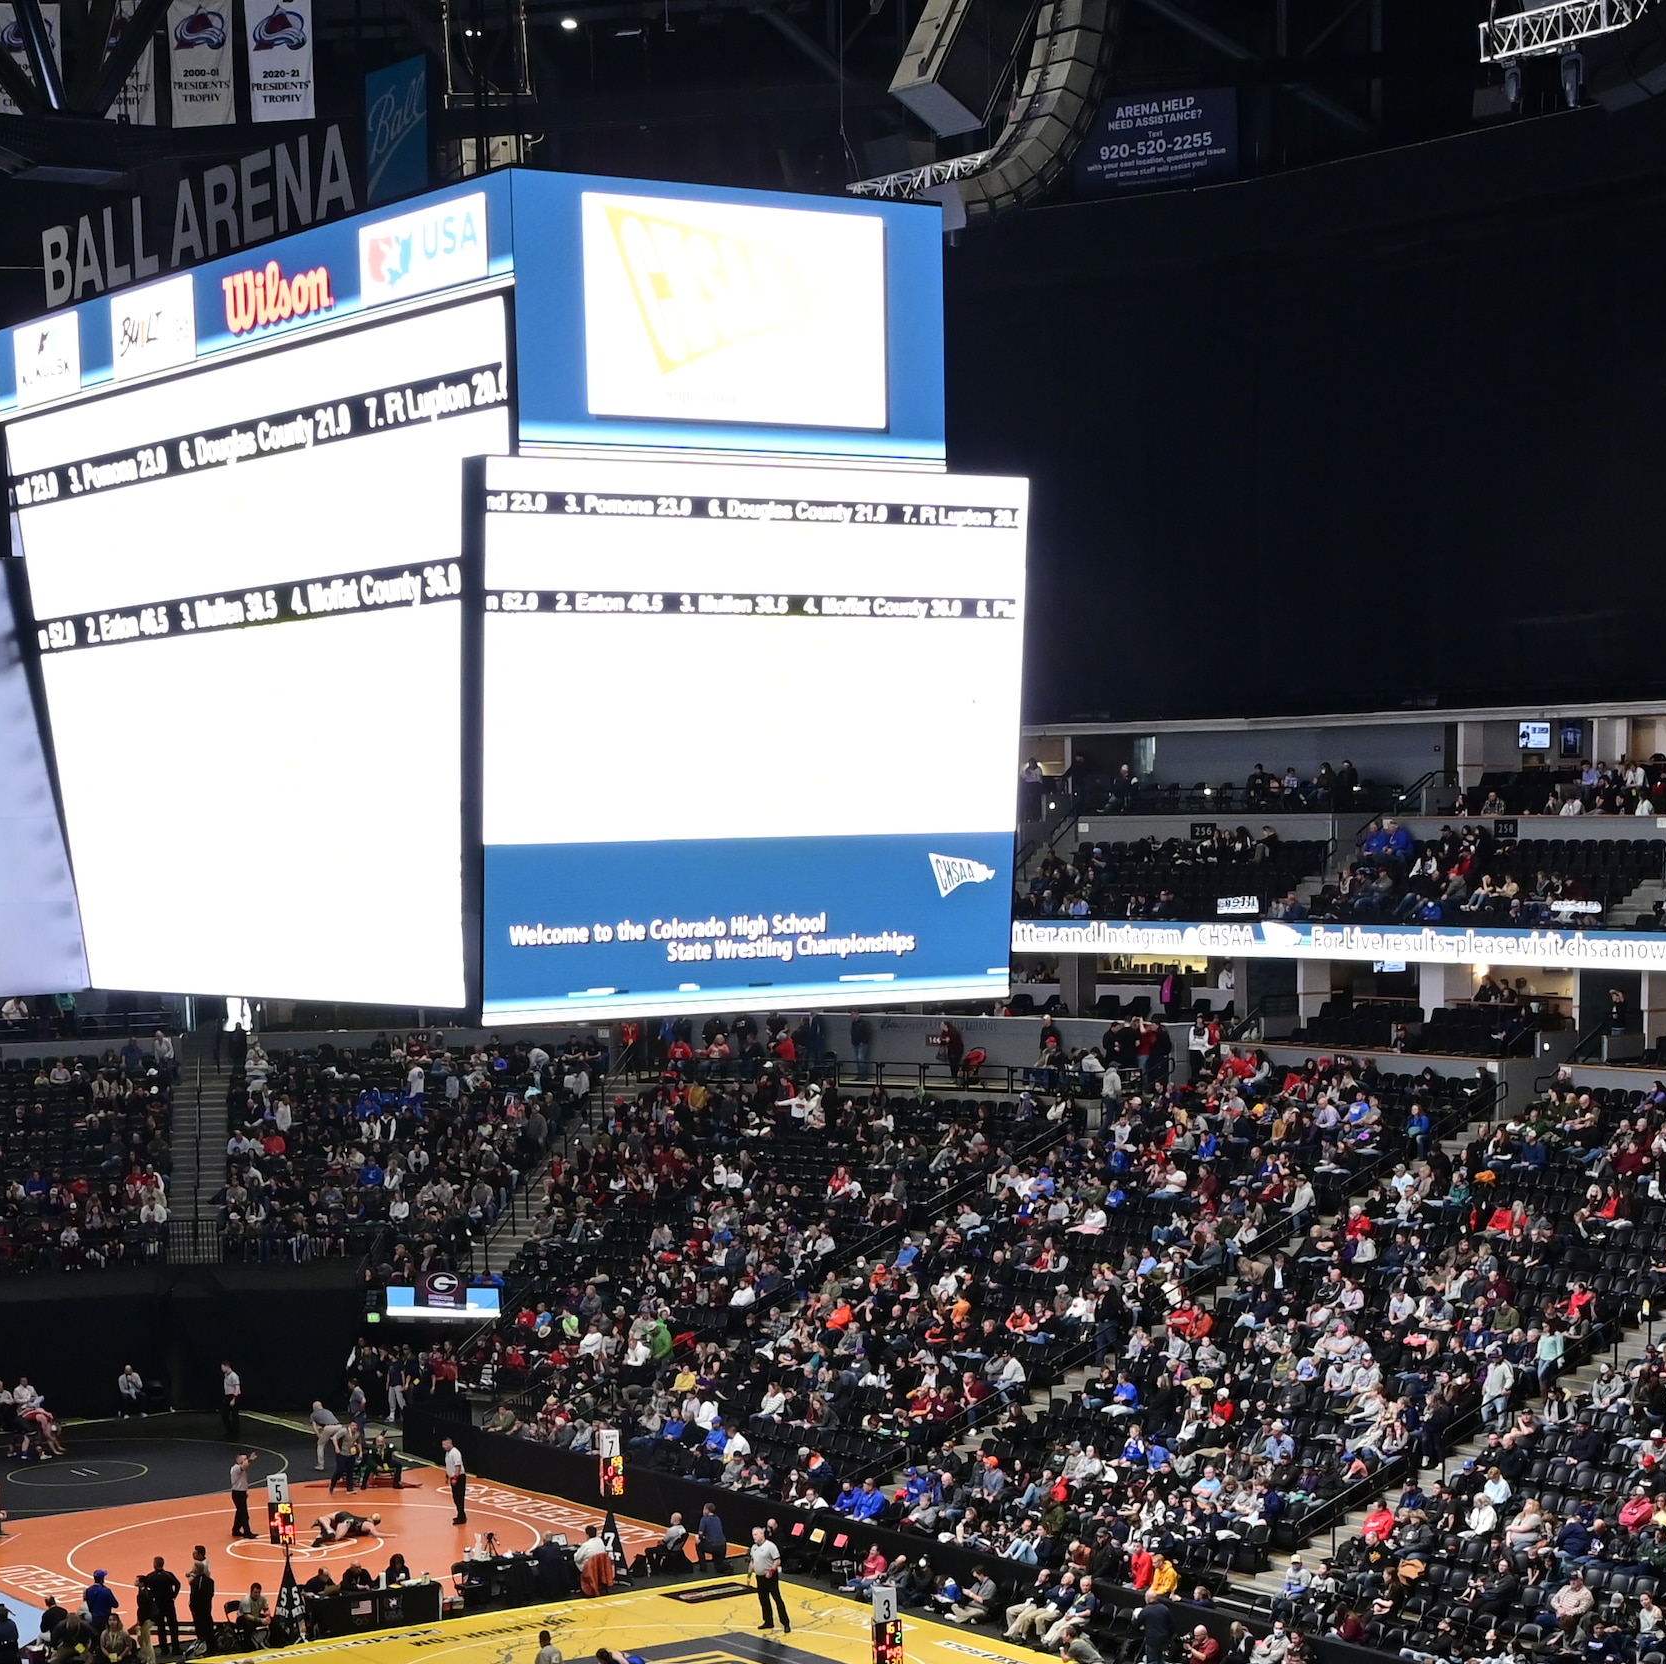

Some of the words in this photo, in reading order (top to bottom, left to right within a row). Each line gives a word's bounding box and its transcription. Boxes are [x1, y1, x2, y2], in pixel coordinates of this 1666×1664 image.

[182, 69, 220, 78] 2000-01
[262, 70, 301, 79] 2020-21
[251, 82, 311, 92] PRESIDENTS'
[183, 94, 221, 103] TROPHY
[262, 94, 302, 104] TROPHY
[1116, 102, 1159, 119] ARENA
[1162, 97, 1195, 113] HELP
[1108, 118, 1133, 131] NEED
[1135, 109, 1203, 127] ASSISTANCE?
[1100, 131, 1212, 160] 920-520-2255
[41, 197, 159, 308] BALL
[170, 124, 356, 268] ARENA
[422, 211, 489, 260] USA
[222, 260, 333, 334] Wilson
[83, 457, 138, 490] Pomona
[136, 446, 168, 478] 23.0
[195, 429, 257, 466] Douglas
[257, 413, 314, 452] County
[315, 403, 351, 440] 21.0
[365, 397, 384, 429] 7.
[385, 391, 406, 425] Ft
[406, 381, 470, 423] Lupton
[510, 492, 547, 513] 23.0
[584, 494, 654, 516] Pomona
[656, 497, 692, 517] 23.0
[727, 500, 793, 521] Douglas
[795, 501, 853, 524] County
[854, 503, 888, 523] 21.0
[902, 505, 917, 524] 7.
[919, 506, 936, 525] Ft
[939, 506, 991, 528] Lupton
[99, 613, 140, 642] Eaton
[195, 596, 244, 629] Mullen
[307, 578, 360, 613] Moffat
[360, 570, 422, 607] County
[423, 563, 461, 598] 36.0
[555, 593, 572, 612] 2.
[575, 592, 625, 612] Eaton
[698, 594, 752, 614] Mullen
[821, 597, 871, 616] Moffat
[873, 598, 928, 619] County
[1194, 827, 1212, 836] 256
[1497, 823, 1514, 834] 258
[509, 923, 590, 947] Welcome
[593, 926, 614, 944] to
[617, 920, 646, 942] the
[650, 916, 727, 941] Colorado
[730, 915, 769, 940] High
[773, 911, 827, 934] School
[667, 940, 711, 962] State
[714, 935, 792, 963] Wrestling
[797, 932, 916, 958] Championships
[1060, 925, 1095, 944] and
[1099, 923, 1181, 947] Instagram
[1312, 930, 1343, 948] For
[1456, 931, 1516, 958] please
[278, 1504, 291, 1514] 105
[279, 1535, 294, 1544] 147
[883, 1599, 891, 1619] 3
[886, 1622, 901, 1634] 161
